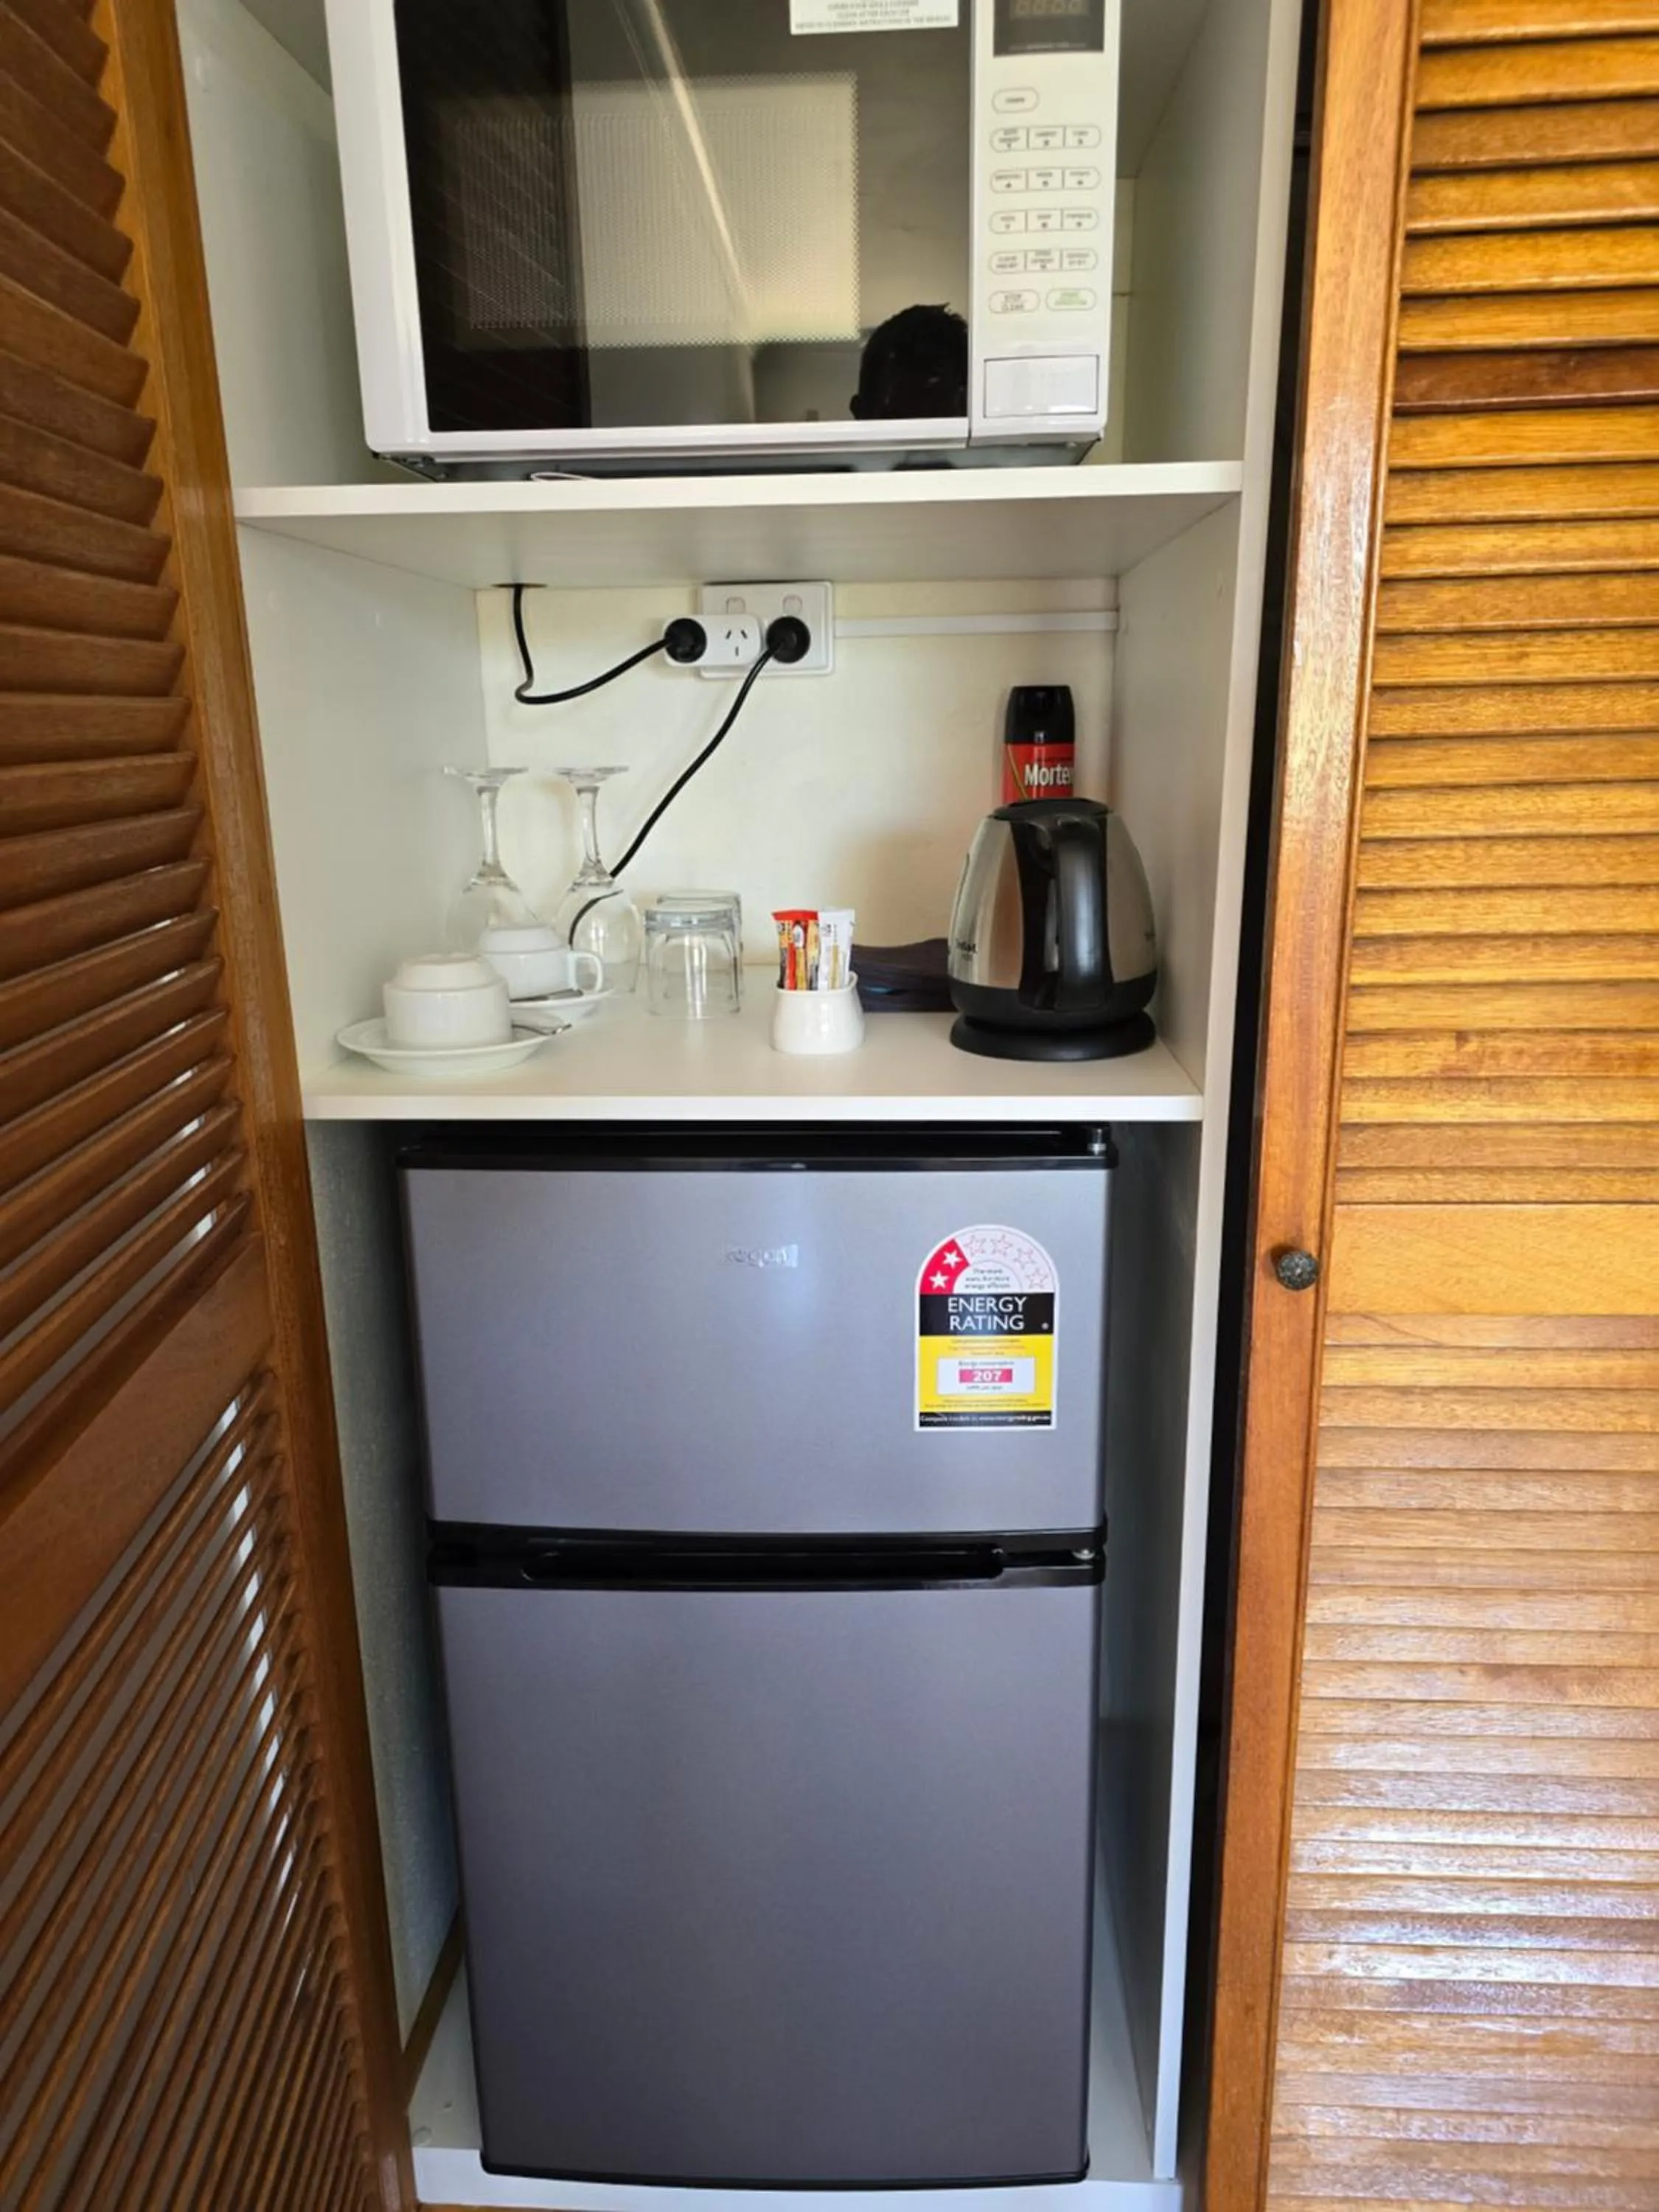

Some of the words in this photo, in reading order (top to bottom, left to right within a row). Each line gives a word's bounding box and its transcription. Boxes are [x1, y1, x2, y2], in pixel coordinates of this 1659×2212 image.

[947, 1296, 1027, 1312] ENERGY
[949, 1314, 1025, 1332] RATING
[973, 1370, 1002, 1382] 207
